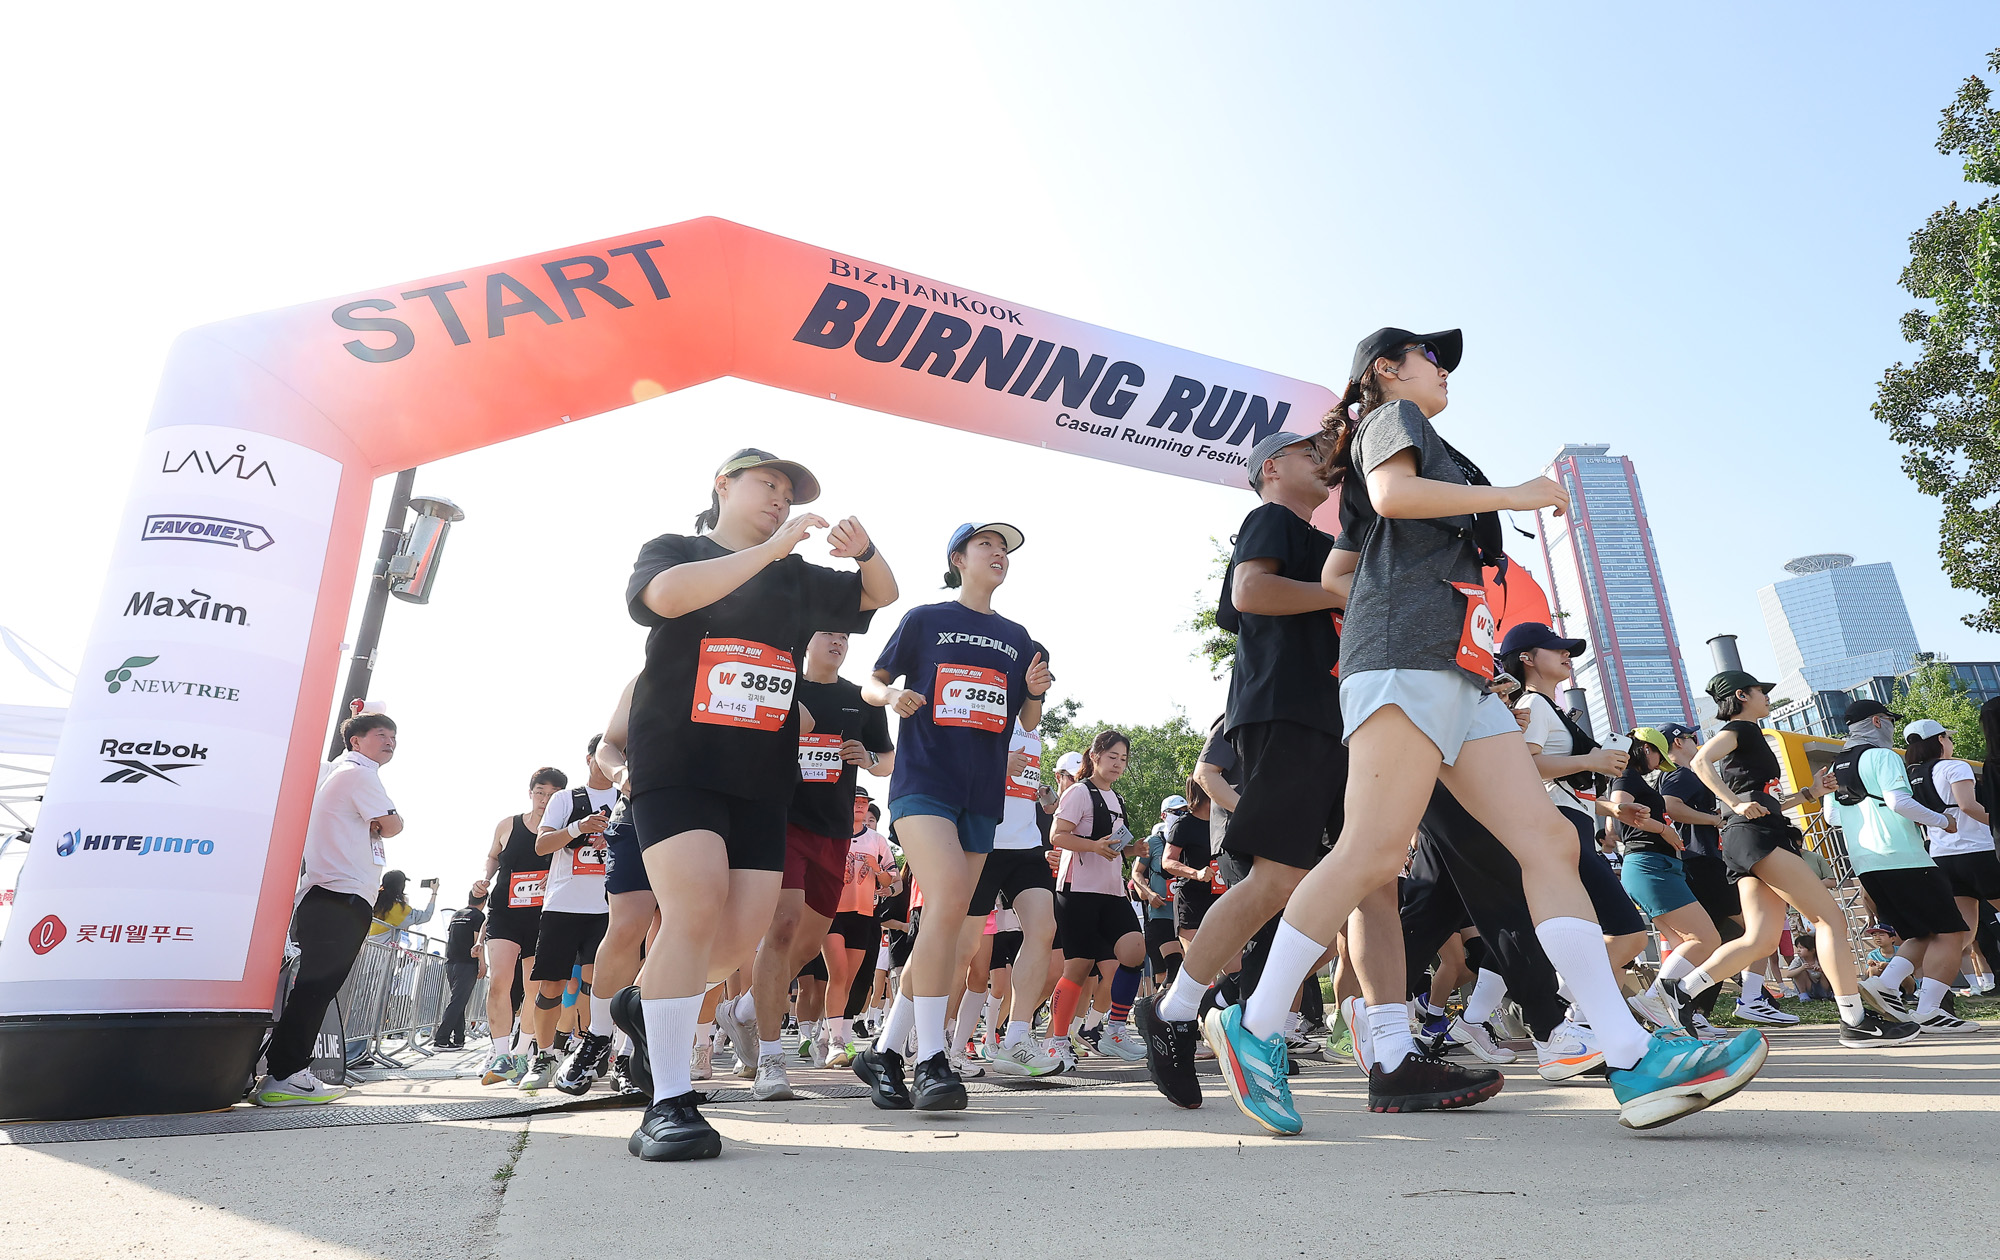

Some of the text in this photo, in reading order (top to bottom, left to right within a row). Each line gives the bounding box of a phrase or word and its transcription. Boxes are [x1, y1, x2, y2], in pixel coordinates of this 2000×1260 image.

[332, 239, 671, 363] START
[793, 283, 1291, 449] BURNING RUN
[1055, 413, 1247, 468] Casual Running Festiv
[150, 521, 254, 549] FAVONEX
[123, 588, 248, 626] Maxim
[1477, 614, 1487, 630] W
[706, 644, 762, 656] BURNING RUN
[936, 632, 1019, 661] XPODIUM
[776, 654, 791, 664] 10km
[940, 667, 968, 675] BURNING
[131, 679, 240, 702] NEWTREE
[719, 672, 793, 695] W 3859
[716, 700, 747, 713] A-145
[949, 688, 1005, 705] W 3858
[941, 707, 967, 715] A-148
[99, 739, 208, 760] Reebok
[807, 751, 840, 762] 1595
[76, 924, 194, 944] 롯데웰푸드
[323, 1033, 341, 1059] LINE
